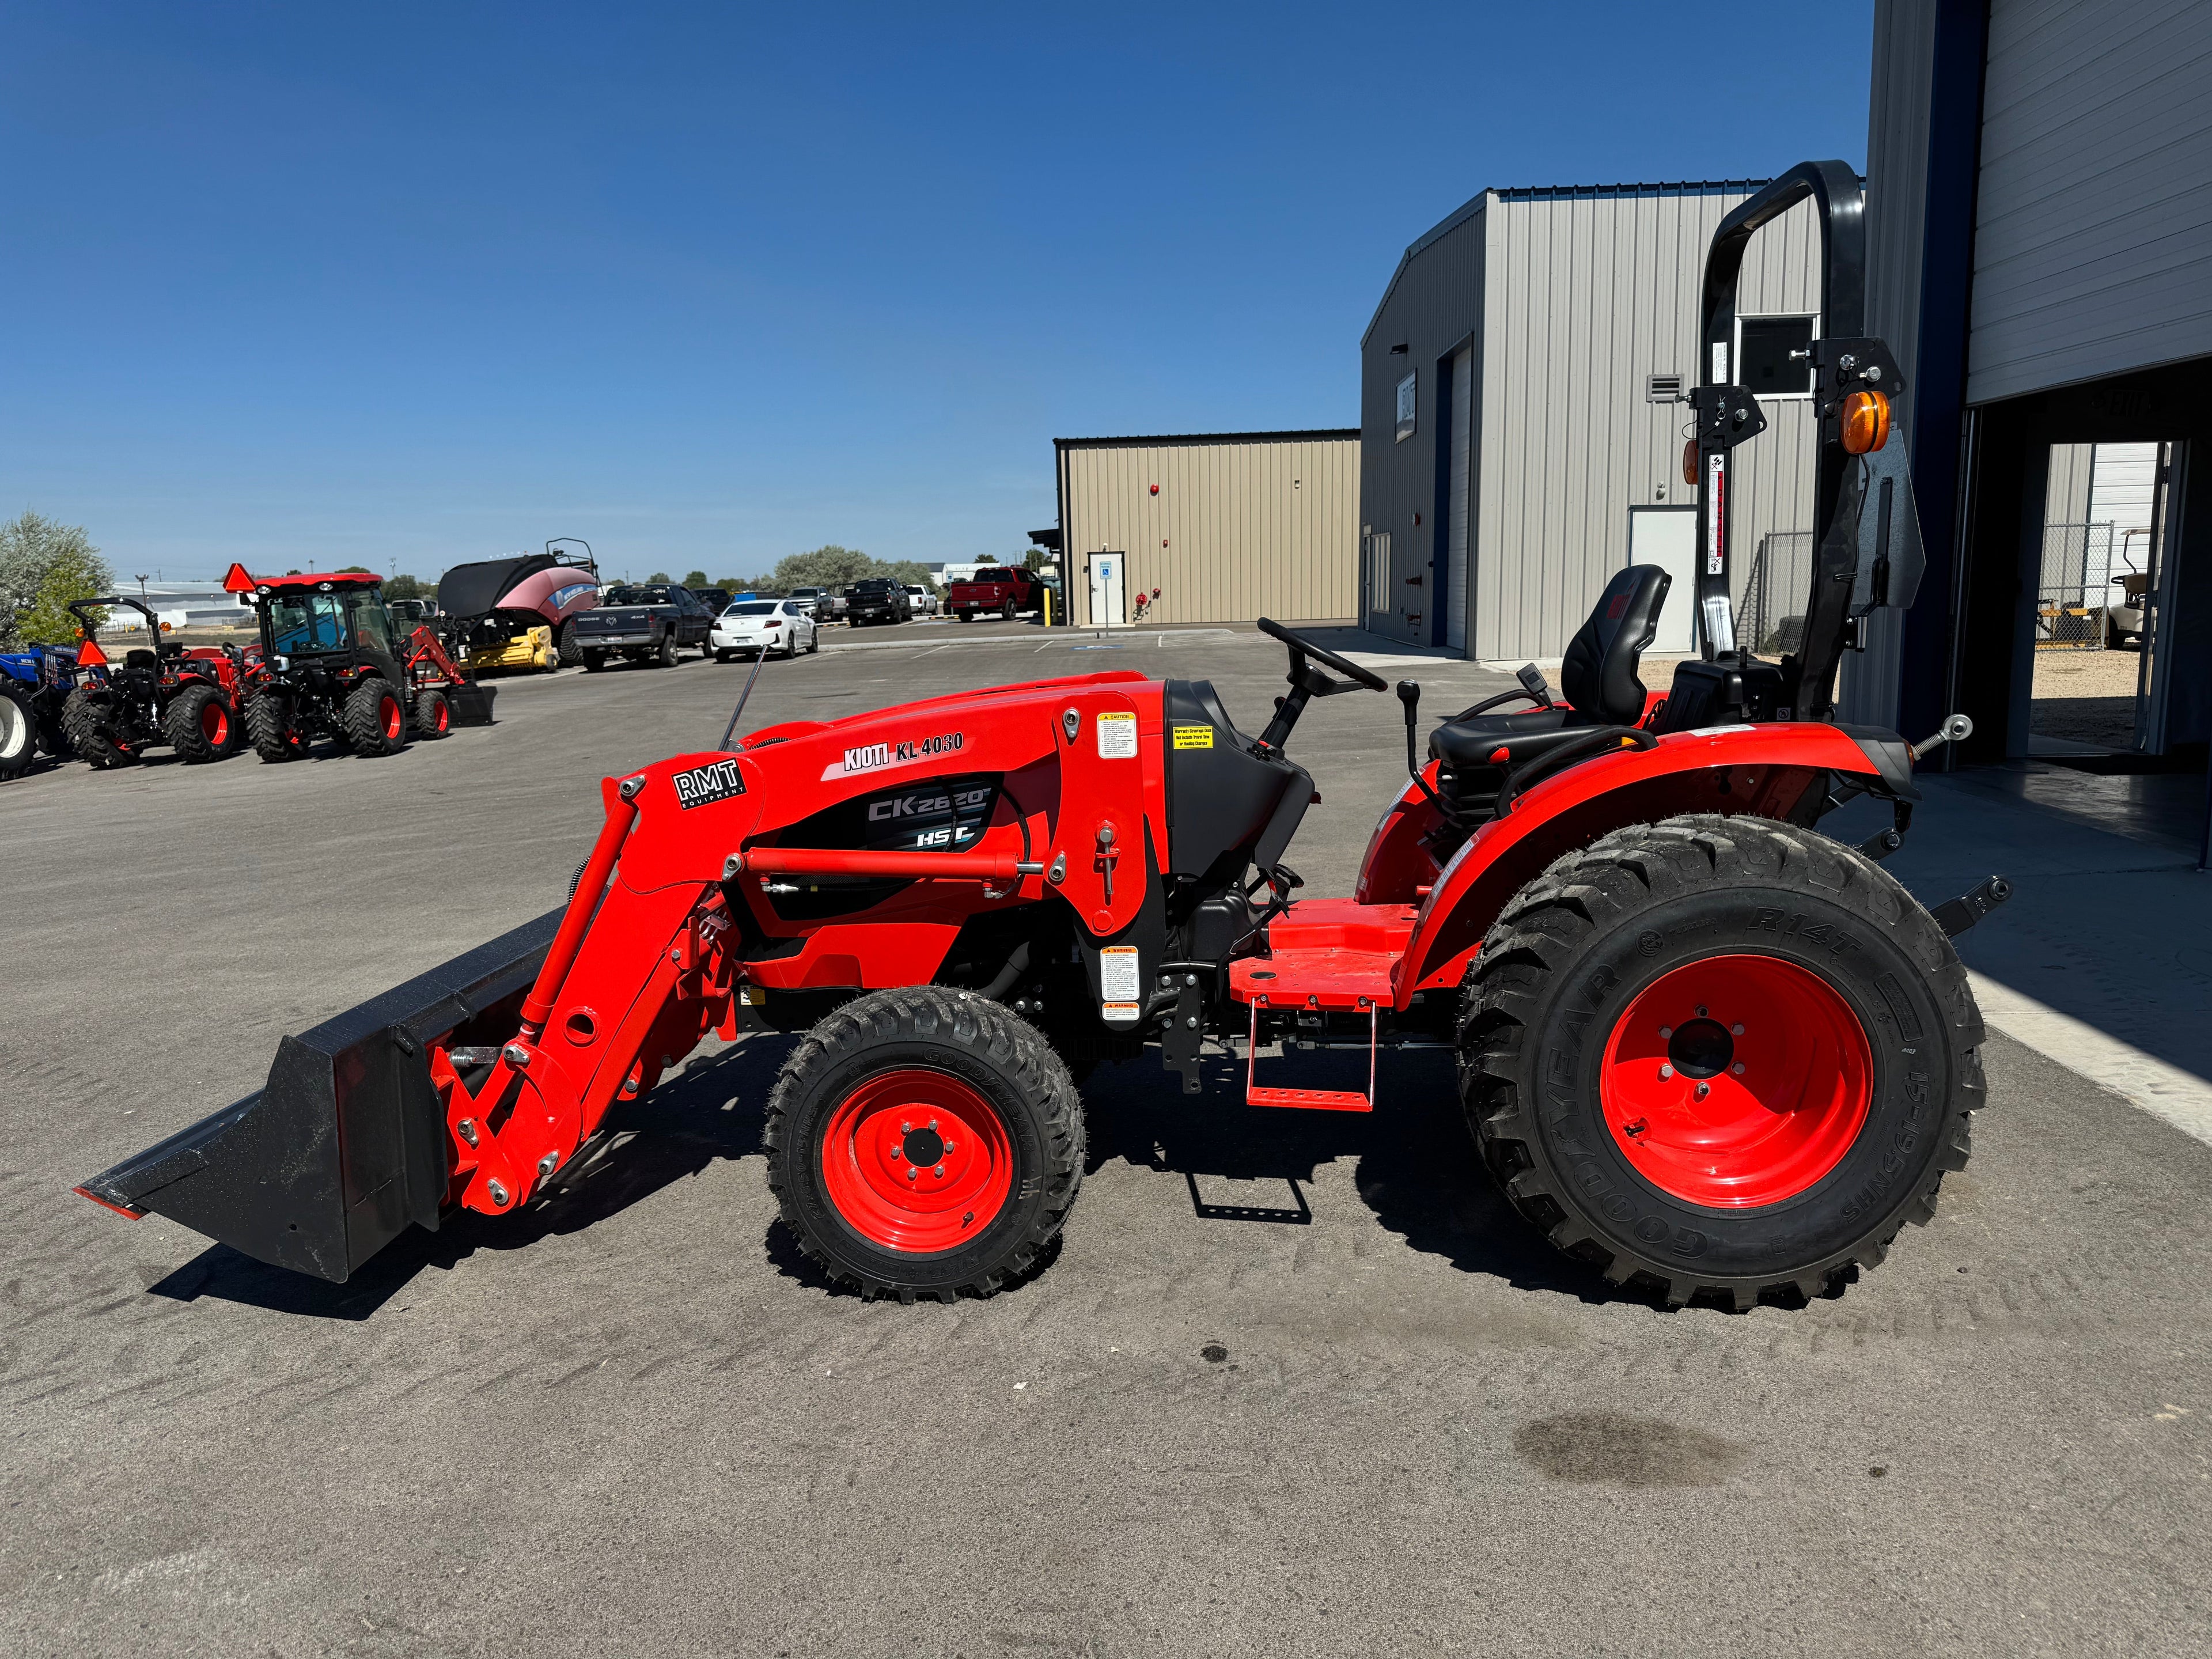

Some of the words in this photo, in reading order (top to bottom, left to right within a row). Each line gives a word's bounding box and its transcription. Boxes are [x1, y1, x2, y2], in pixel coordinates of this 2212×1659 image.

[2109, 390, 2146, 415] EXIT
[843, 742, 889, 771] KIOTI
[896, 741, 919, 762] KL
[920, 732, 964, 757] 4030
[673, 759, 737, 801] RMT
[682, 787, 743, 808] EQUIPMENT
[916, 827, 968, 847] HST
[1745, 907, 1866, 955] R14T
[924, 1048, 1035, 1152] GOODYEAR
[1547, 965, 1709, 1259] GOODYEAR
